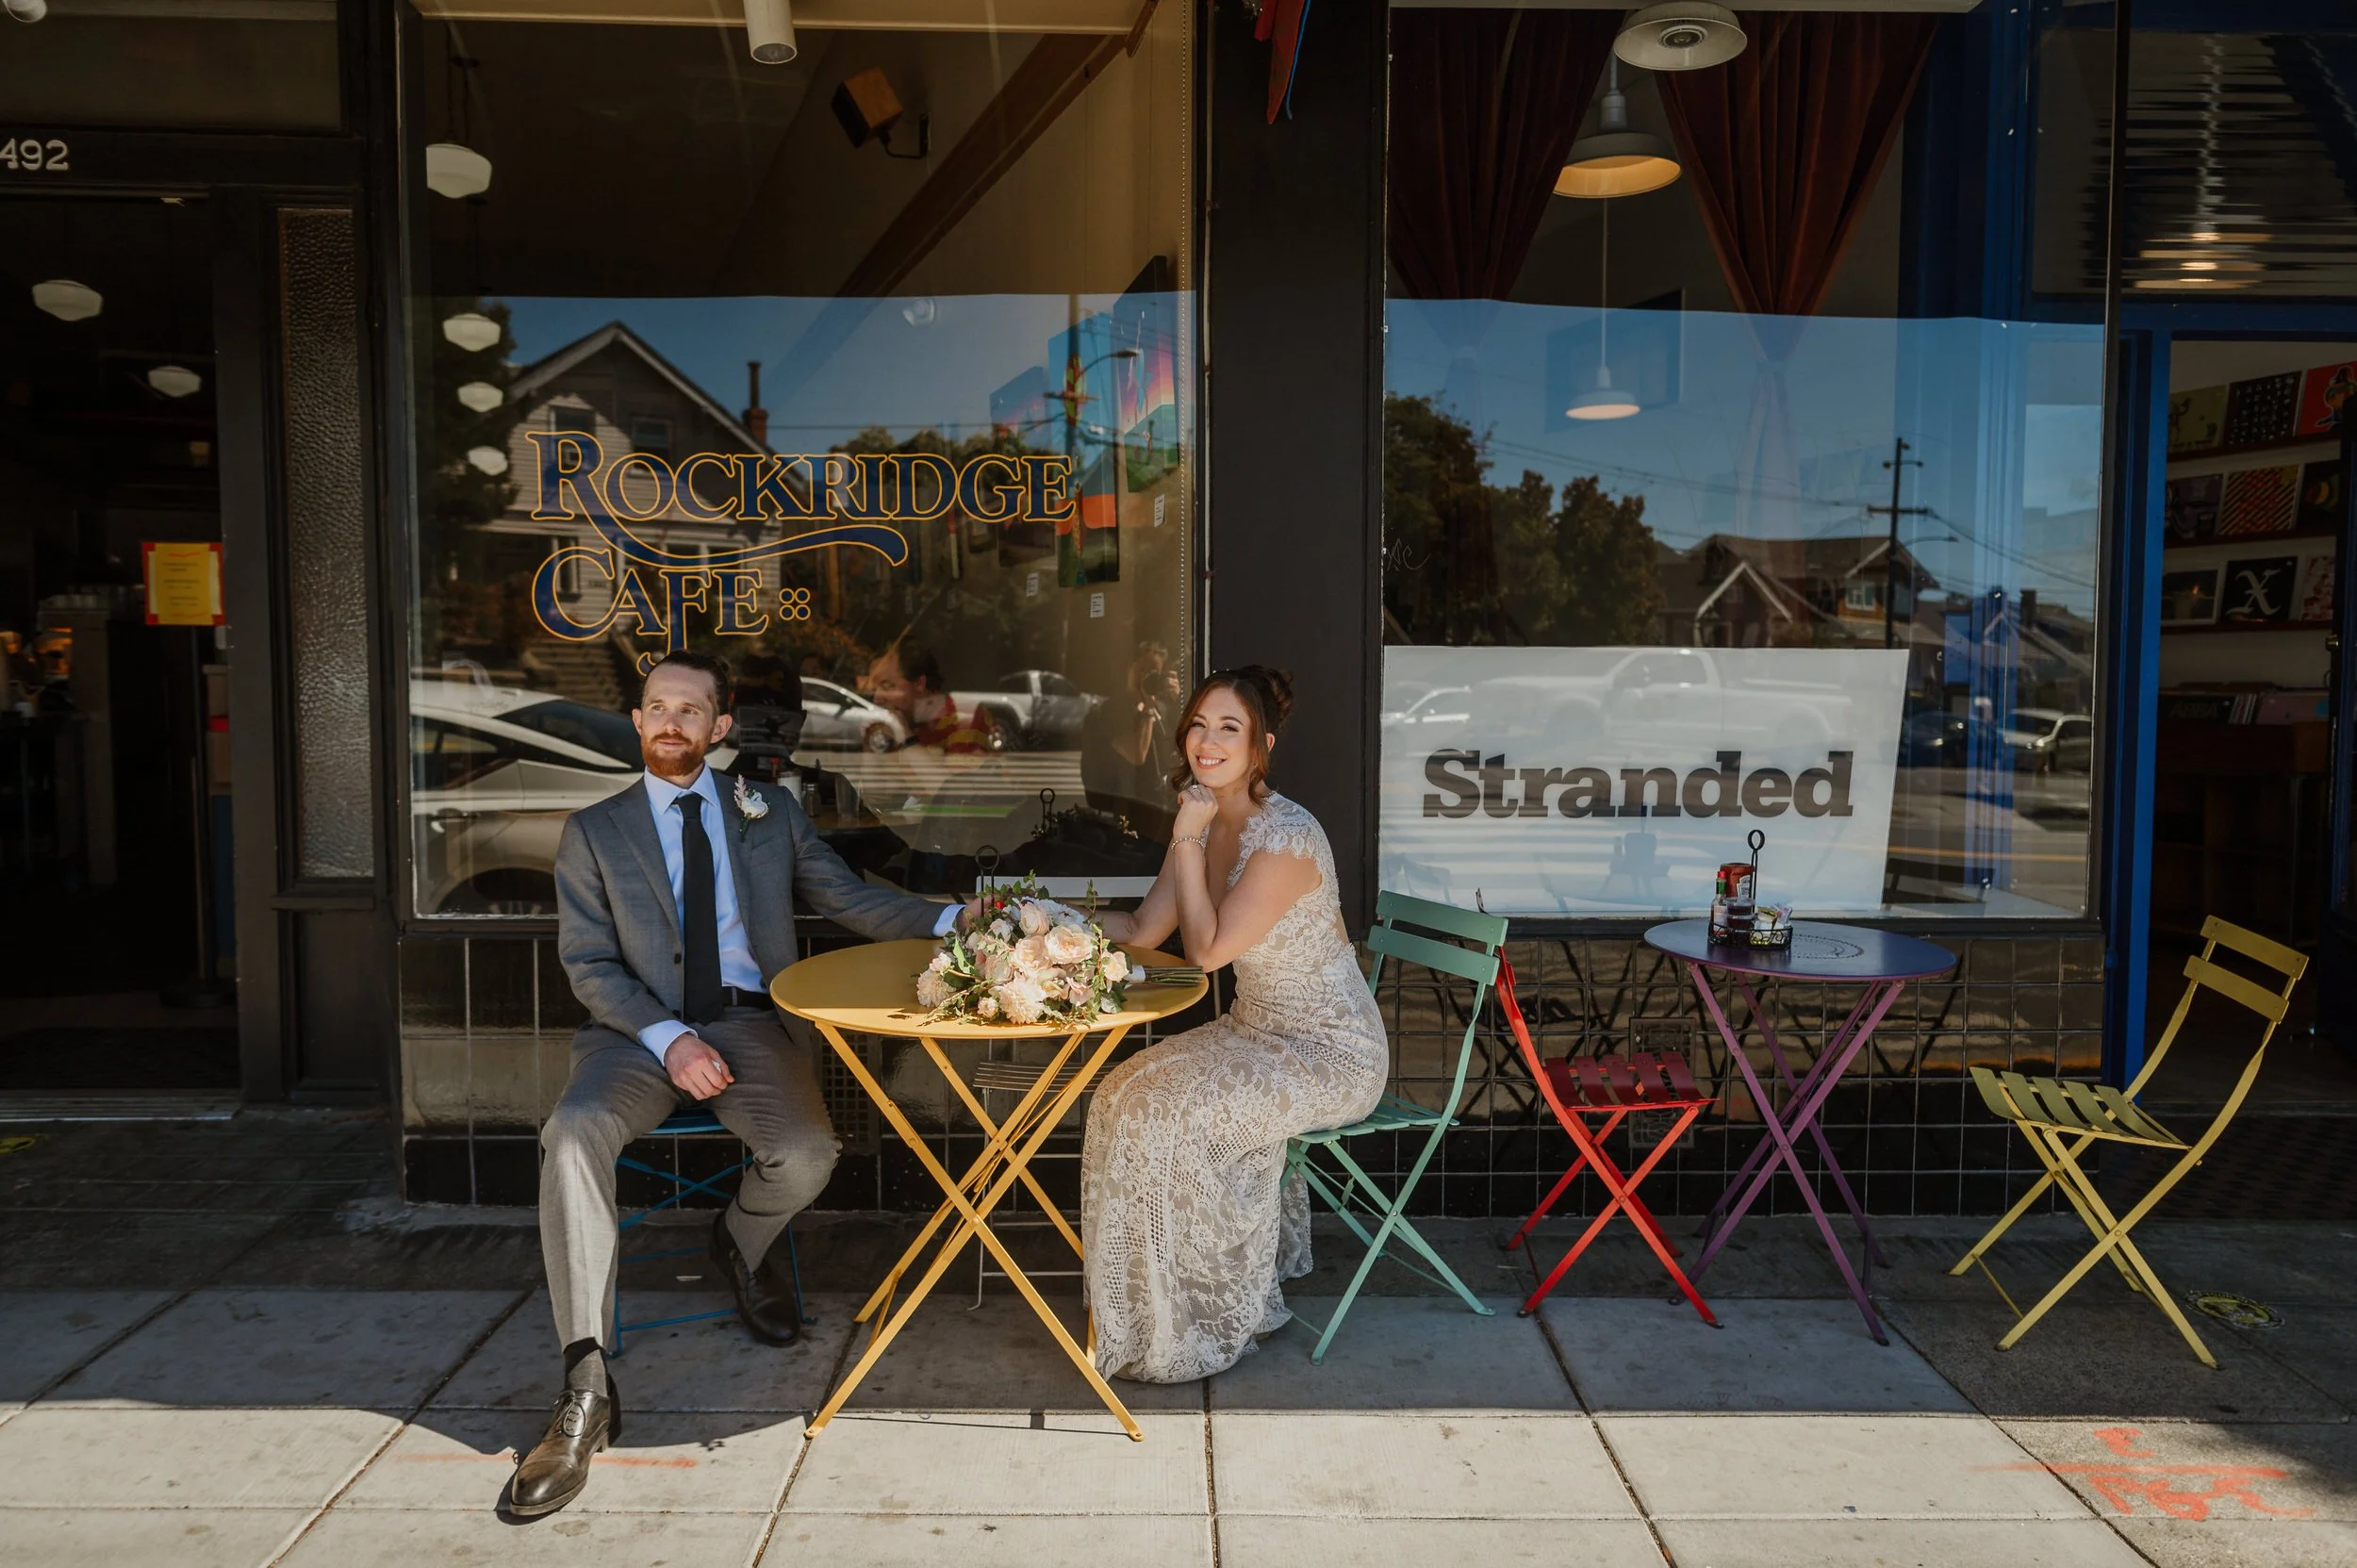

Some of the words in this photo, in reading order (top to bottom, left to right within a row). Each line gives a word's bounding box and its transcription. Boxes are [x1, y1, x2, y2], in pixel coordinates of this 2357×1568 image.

[0, 138, 70, 171] 492
[524, 430, 1077, 569] ROCKRIDGE
[532, 546, 769, 675] CAFE
[1423, 748, 1854, 818] Stranded
